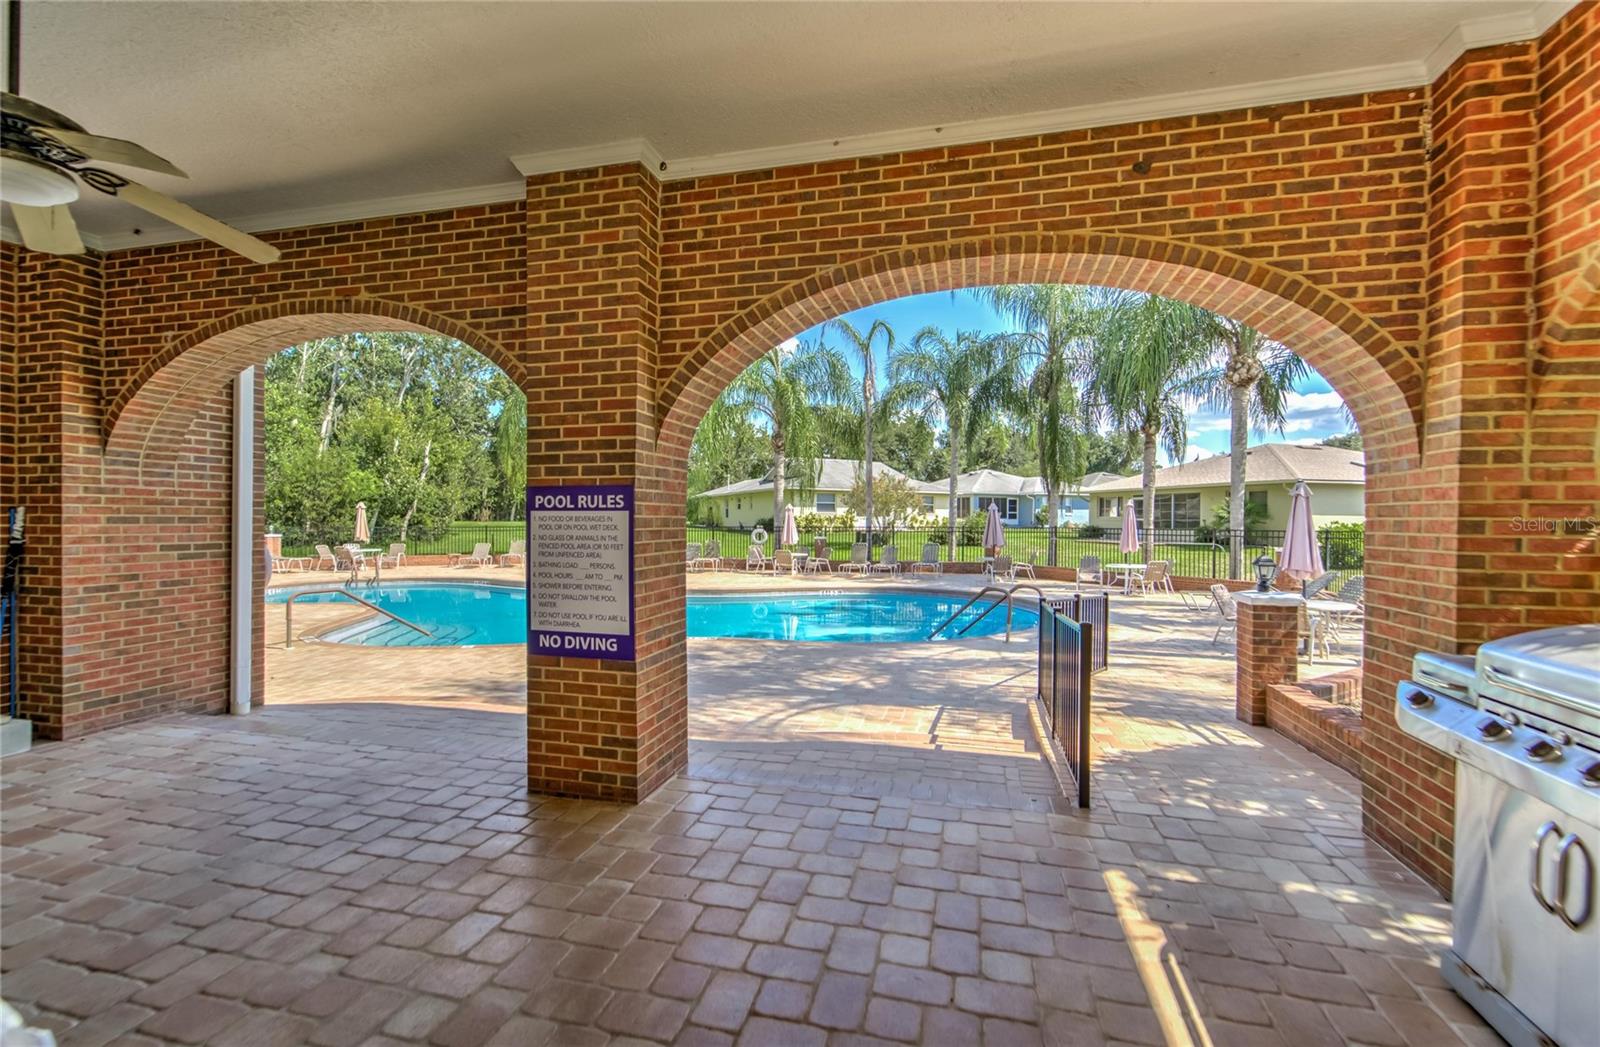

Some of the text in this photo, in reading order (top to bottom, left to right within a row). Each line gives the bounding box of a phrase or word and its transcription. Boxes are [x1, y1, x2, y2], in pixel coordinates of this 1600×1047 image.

[535, 495, 624, 508] POOL RULES
[540, 635, 618, 651] NO DIVING
